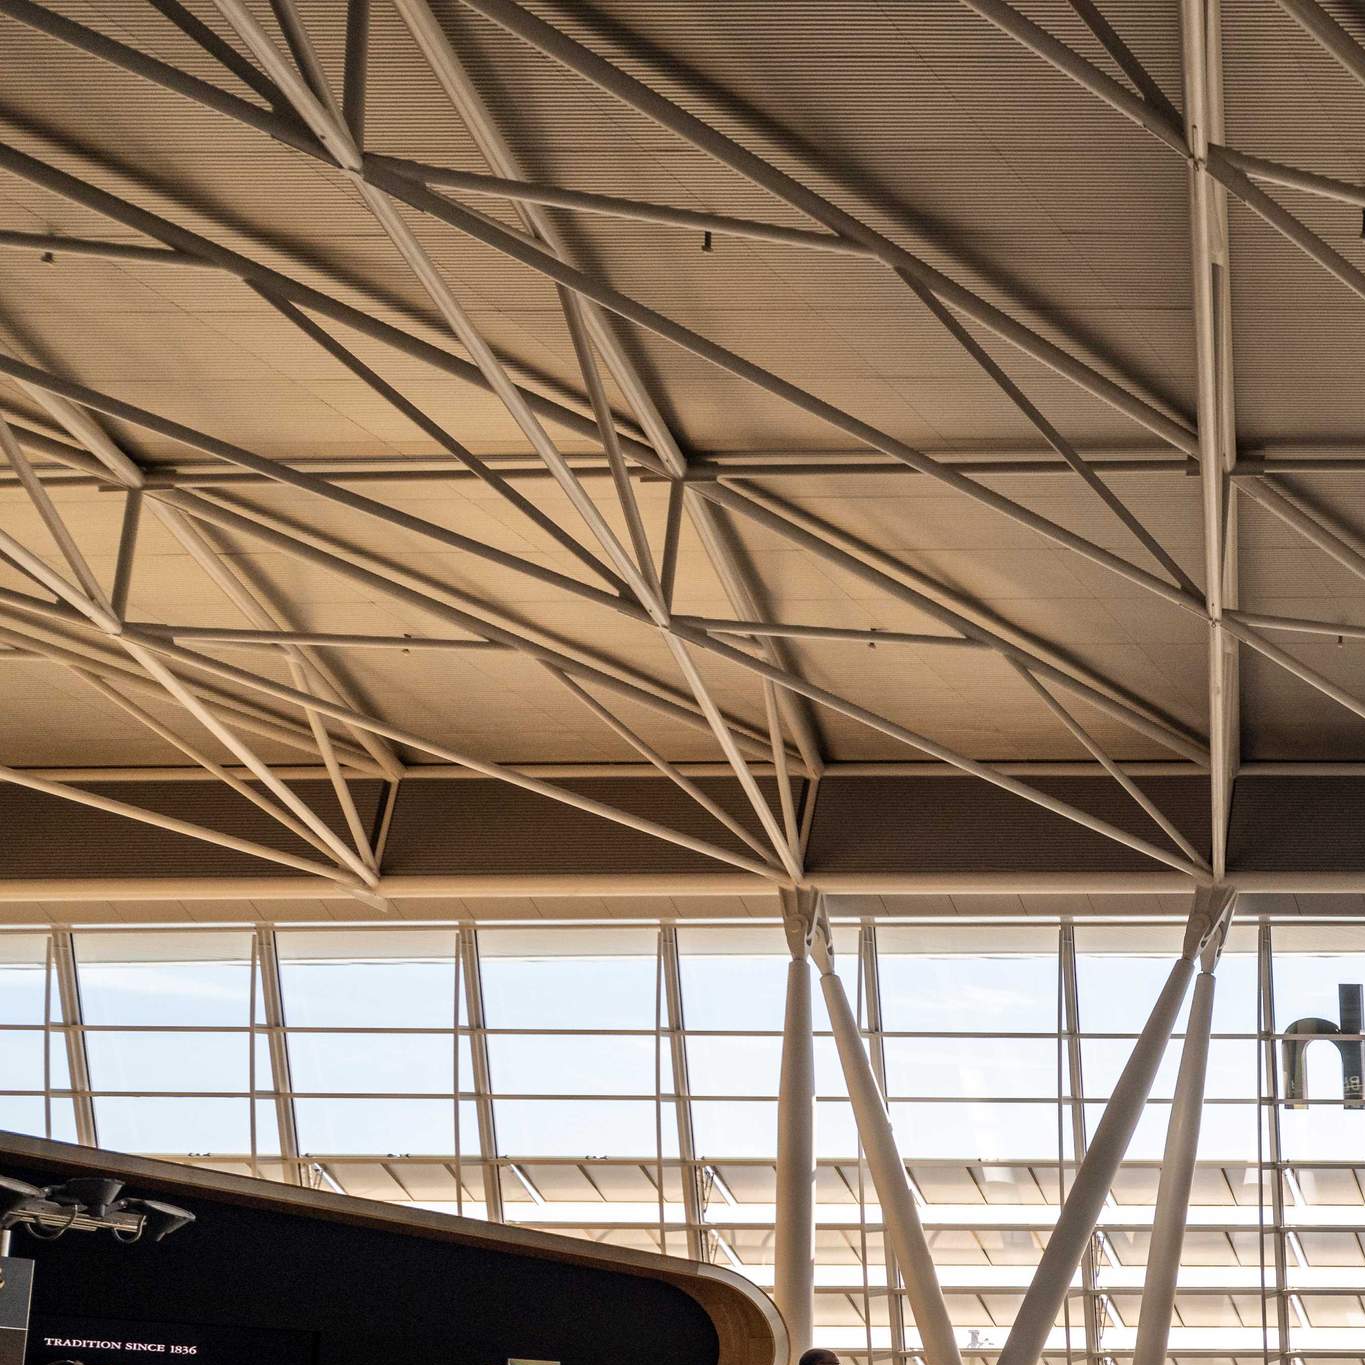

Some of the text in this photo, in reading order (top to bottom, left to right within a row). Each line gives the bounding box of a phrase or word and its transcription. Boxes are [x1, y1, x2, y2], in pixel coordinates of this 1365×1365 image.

[44, 1337, 197, 1355] TRADITION SINCE 1836
